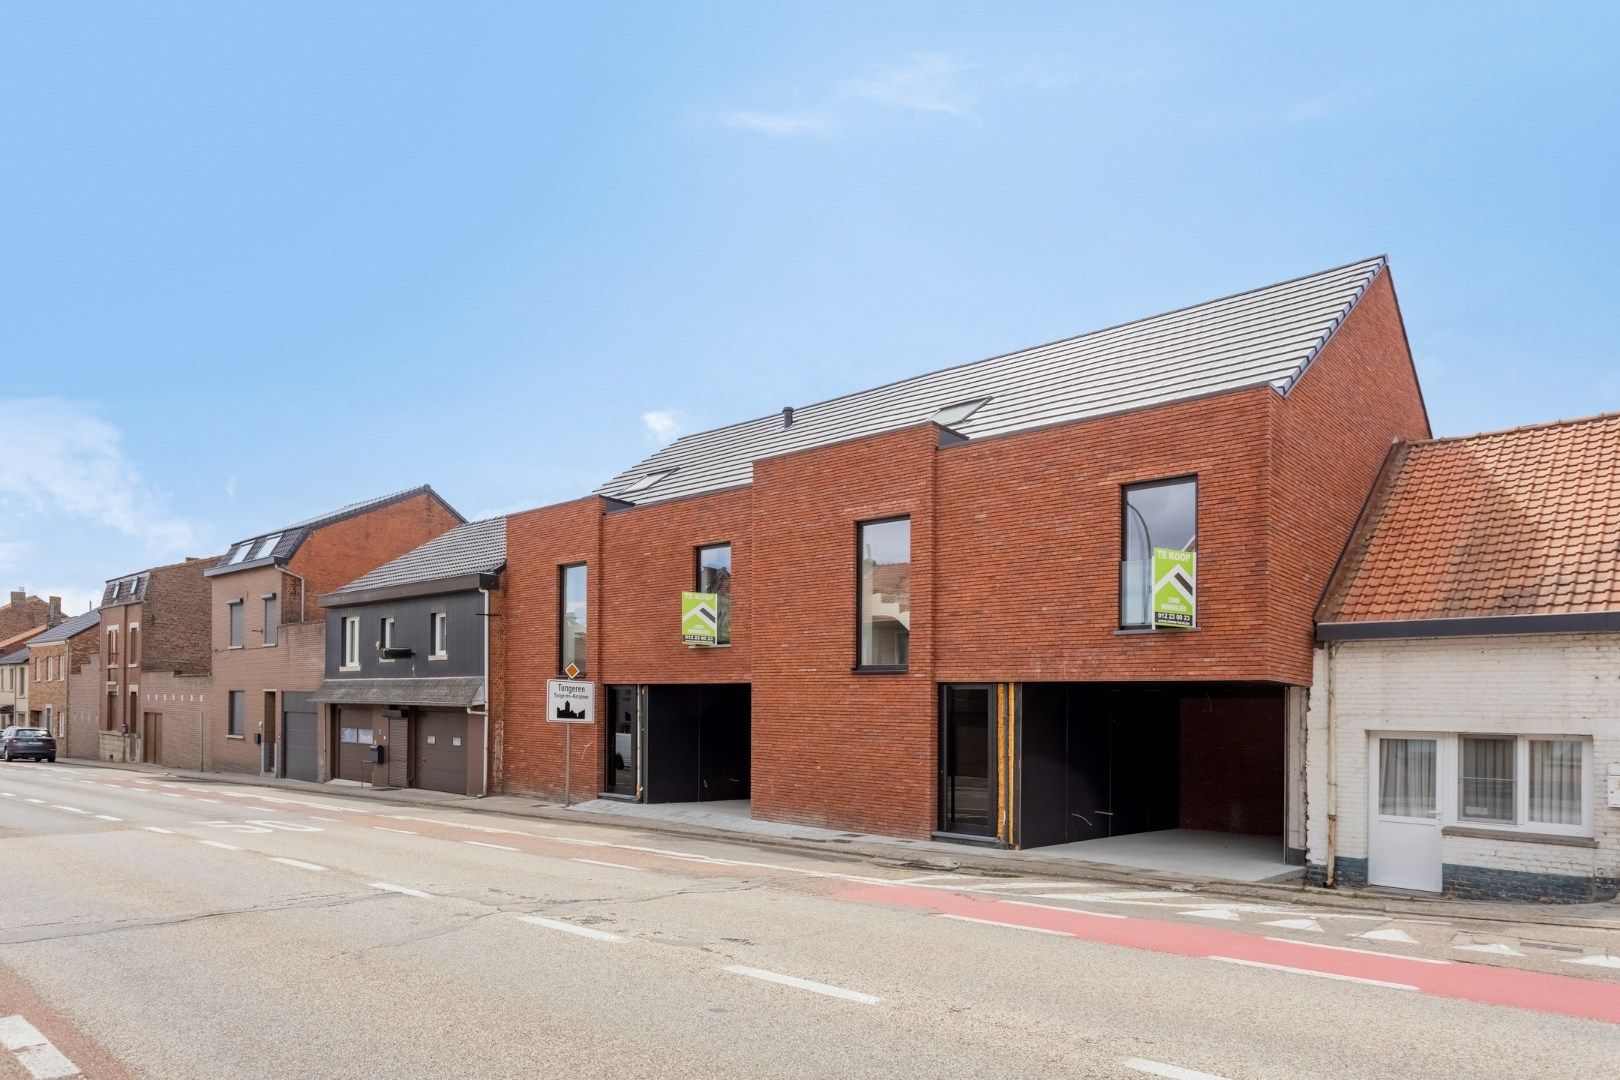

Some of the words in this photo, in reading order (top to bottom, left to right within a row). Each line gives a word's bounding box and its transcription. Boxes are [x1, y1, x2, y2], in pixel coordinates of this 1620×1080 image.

[1157, 550, 1167, 559] TE
[1169, 552, 1190, 562] KOOP
[694, 593, 714, 601] KOOP
[558, 683, 586, 694] Tongeren
